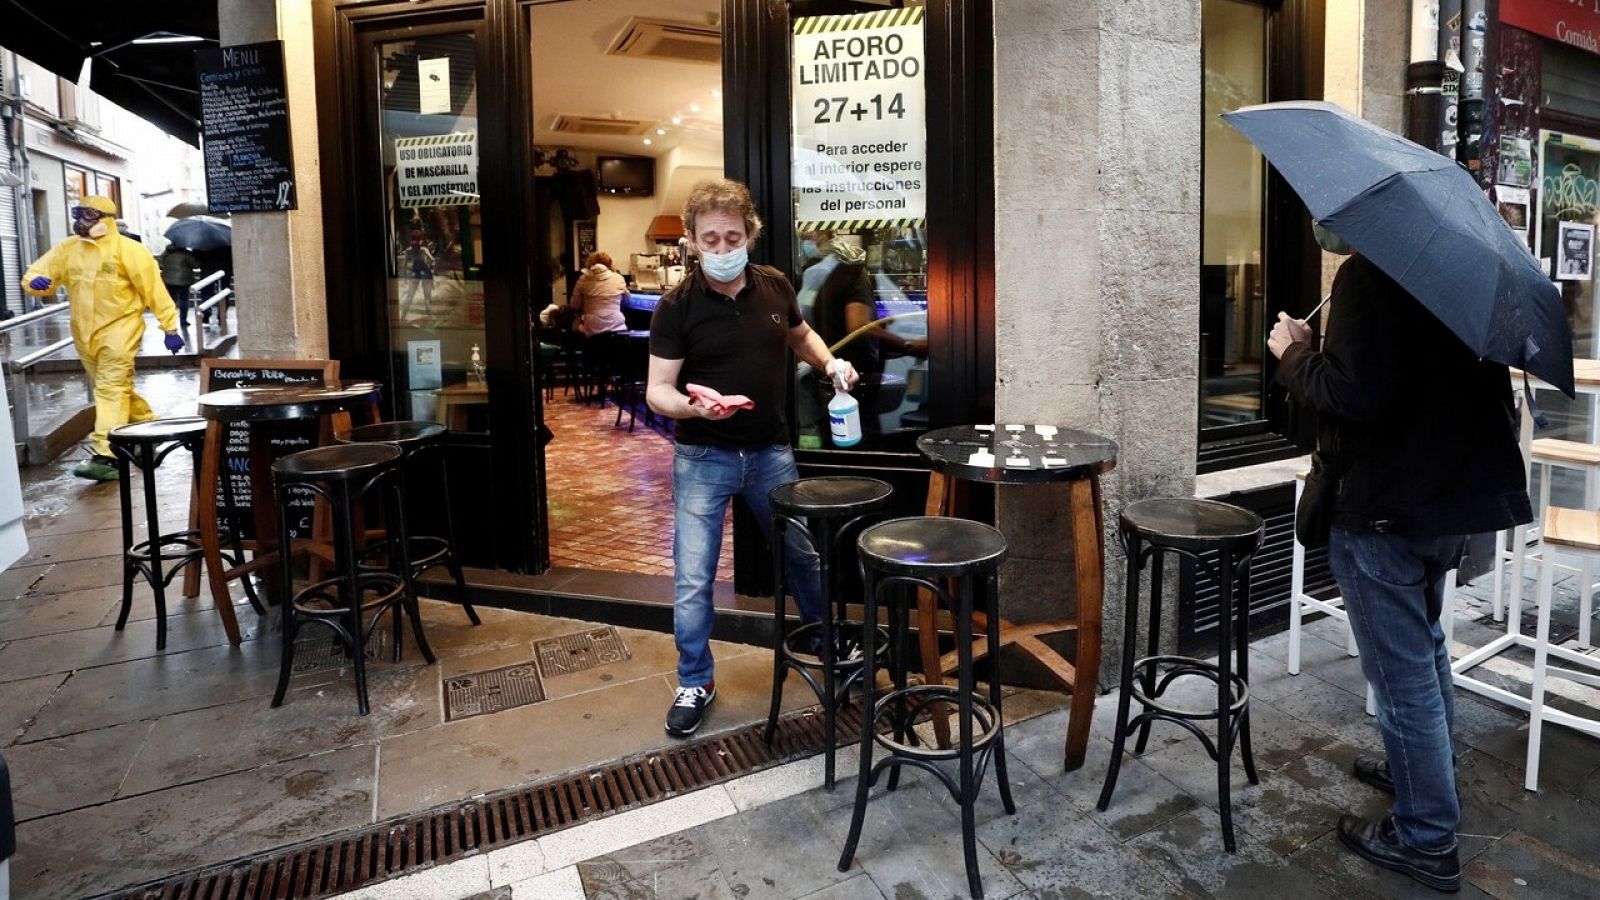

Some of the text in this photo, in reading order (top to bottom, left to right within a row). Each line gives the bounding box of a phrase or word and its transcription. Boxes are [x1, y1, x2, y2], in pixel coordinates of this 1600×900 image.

[1556, 20, 1597, 52] Comida
[814, 34, 903, 60] AFORO
[800, 57, 919, 85] LIMITADO
[814, 93, 905, 124] 27+14
[400, 145, 472, 160] USO OBLIGATORIO
[817, 141, 908, 156] Para acceder
[405, 164, 468, 178] DE MASCARILLA
[805, 159, 921, 176] al interior espere
[401, 186, 405, 197] Y
[407, 185, 420, 197] GEL
[802, 178, 920, 193] las instrucciones
[820, 197, 905, 213] del personal
